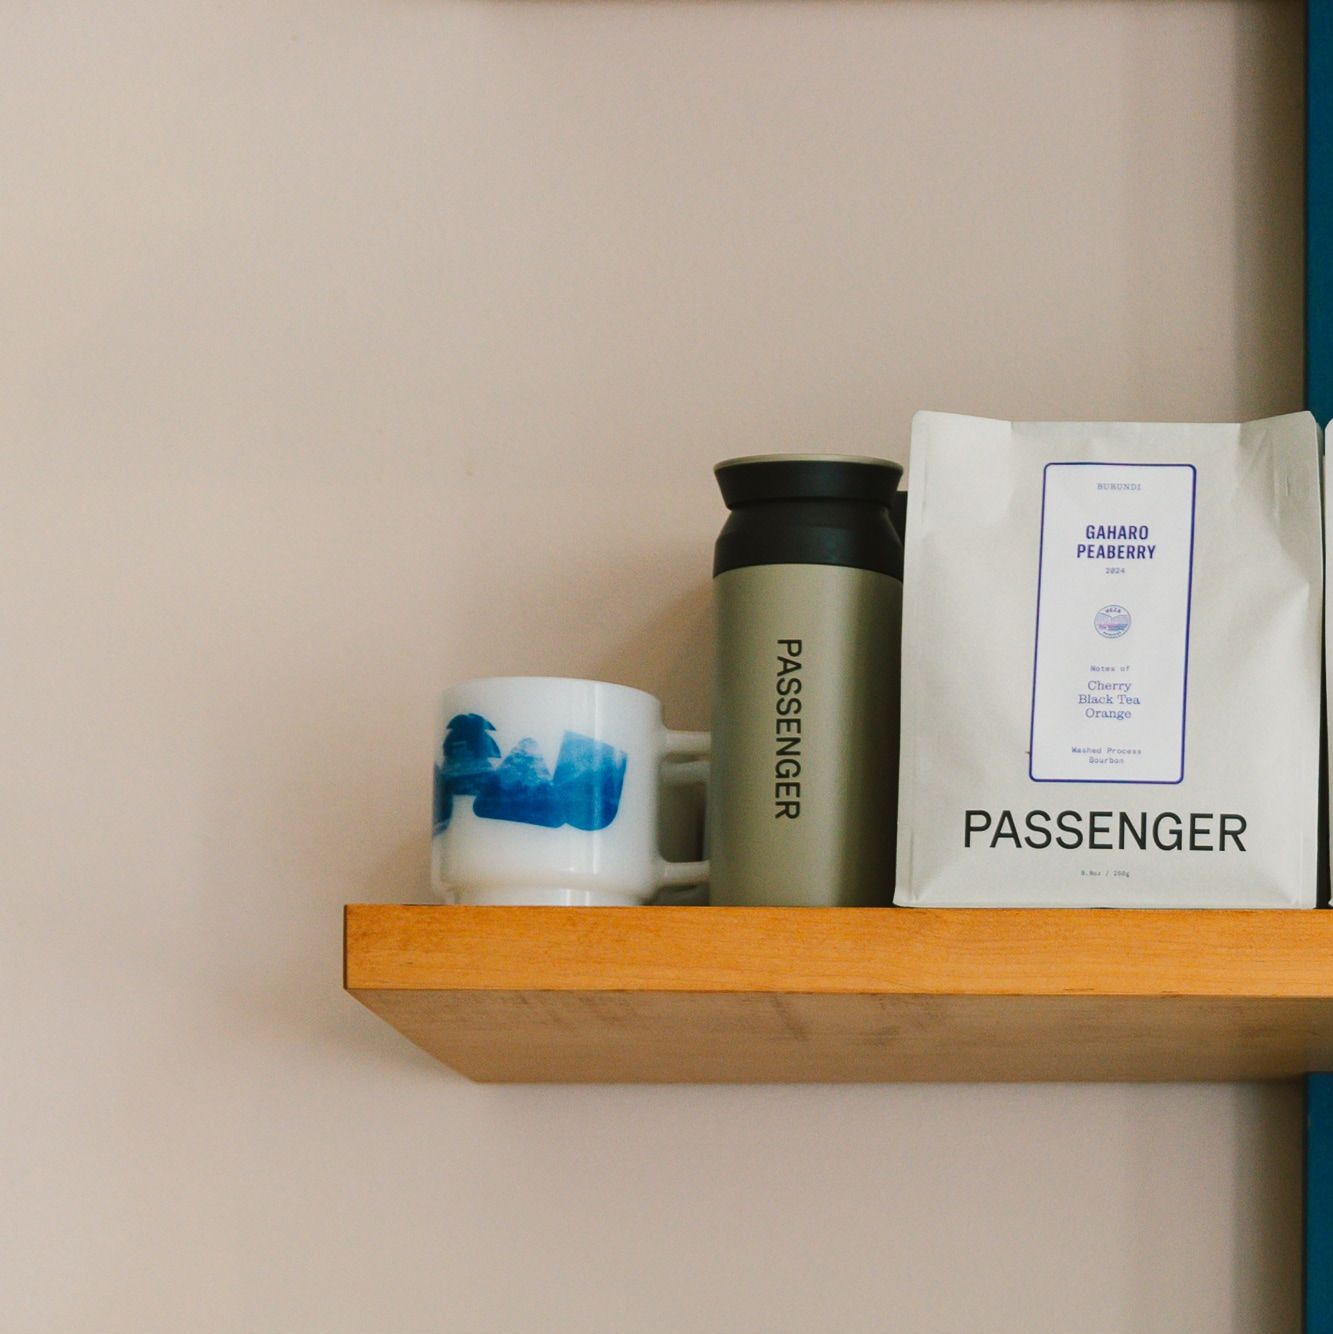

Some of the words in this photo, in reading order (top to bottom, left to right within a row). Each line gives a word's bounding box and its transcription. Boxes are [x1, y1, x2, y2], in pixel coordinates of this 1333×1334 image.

[1085, 524, 1149, 541] GAHARO
[1076, 543, 1156, 560] PEABERRY
[1105, 567, 1126, 575] 2024
[1087, 679, 1132, 693] Cherry
[1078, 693, 1114, 705] Black
[1117, 694, 1141, 705] Tea
[1084, 707, 1132, 721] Orange
[774, 638, 803, 820] PASSENGER
[964, 809, 1248, 852] PASSENGER
